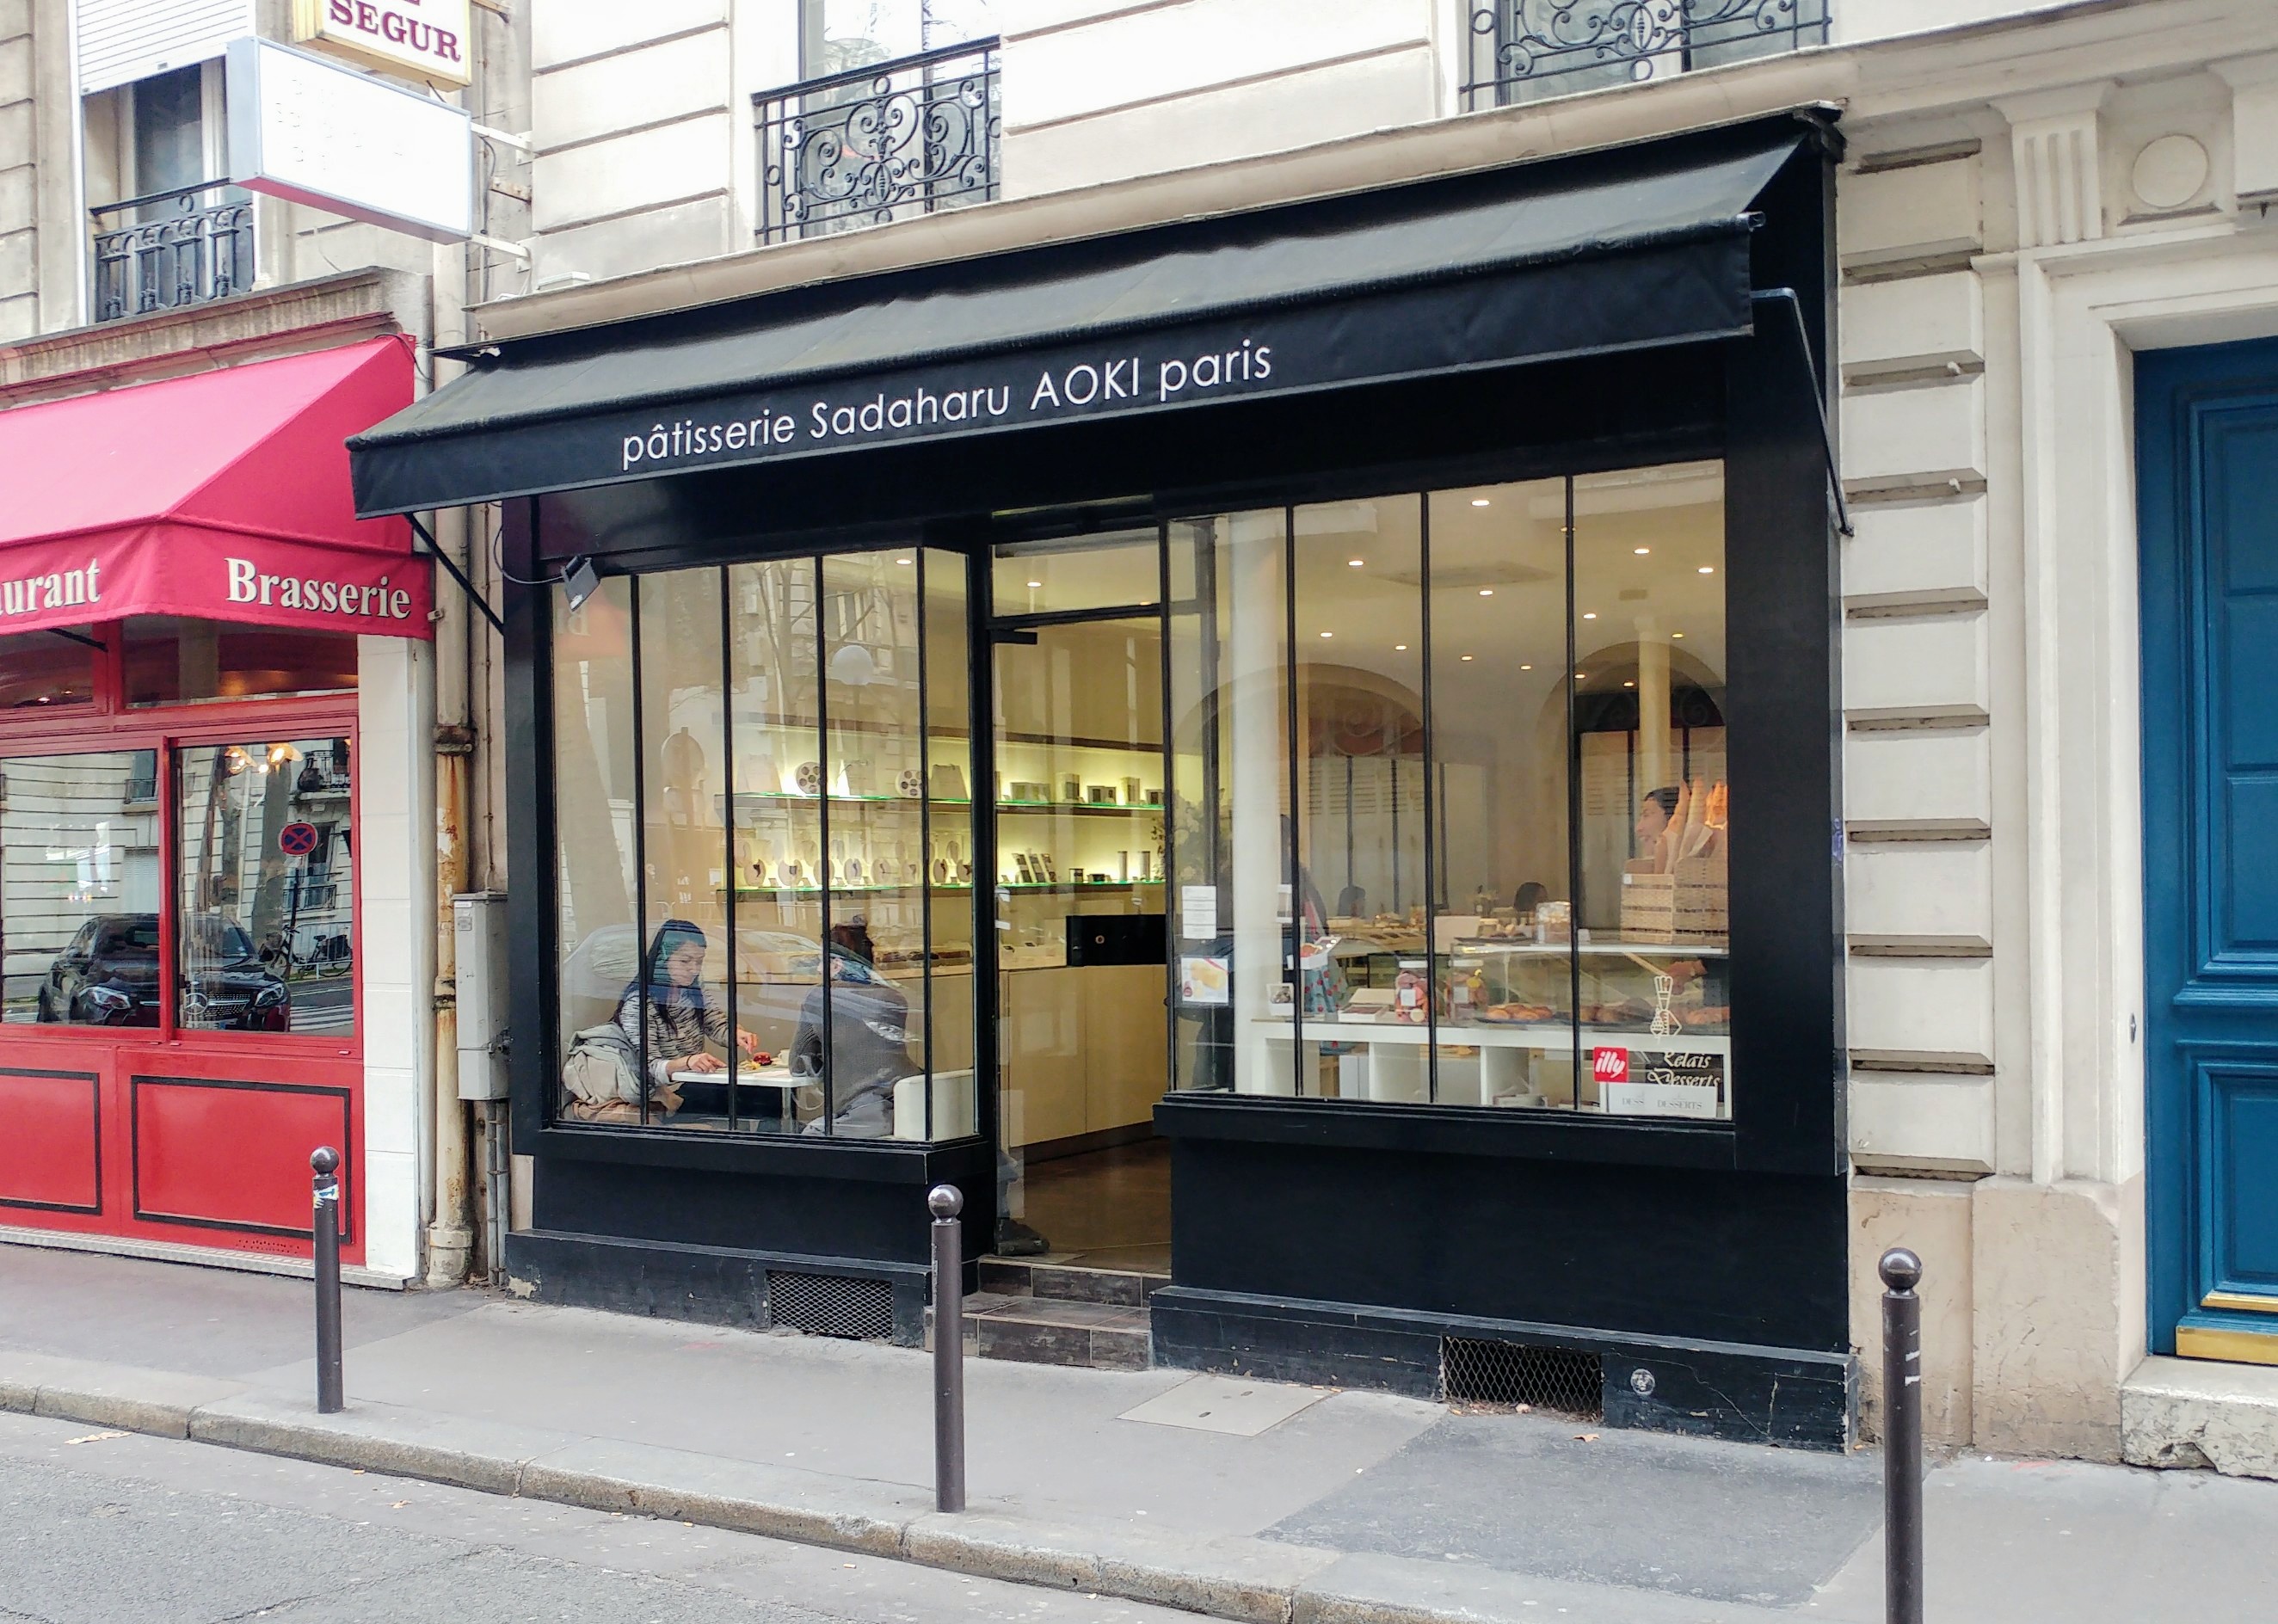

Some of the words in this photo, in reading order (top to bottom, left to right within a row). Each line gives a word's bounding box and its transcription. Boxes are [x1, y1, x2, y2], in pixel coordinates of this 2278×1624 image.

[329, 0, 461, 62] SEGUR
[623, 409, 795, 471] pâtisserie
[810, 385, 1009, 439] Sadaharu
[1030, 357, 1139, 410] AOKI
[1160, 338, 1271, 402] paris
[0, 557, 101, 616] urant
[225, 557, 411, 618] Brasserie
[1596, 1051, 1625, 1079] illy
